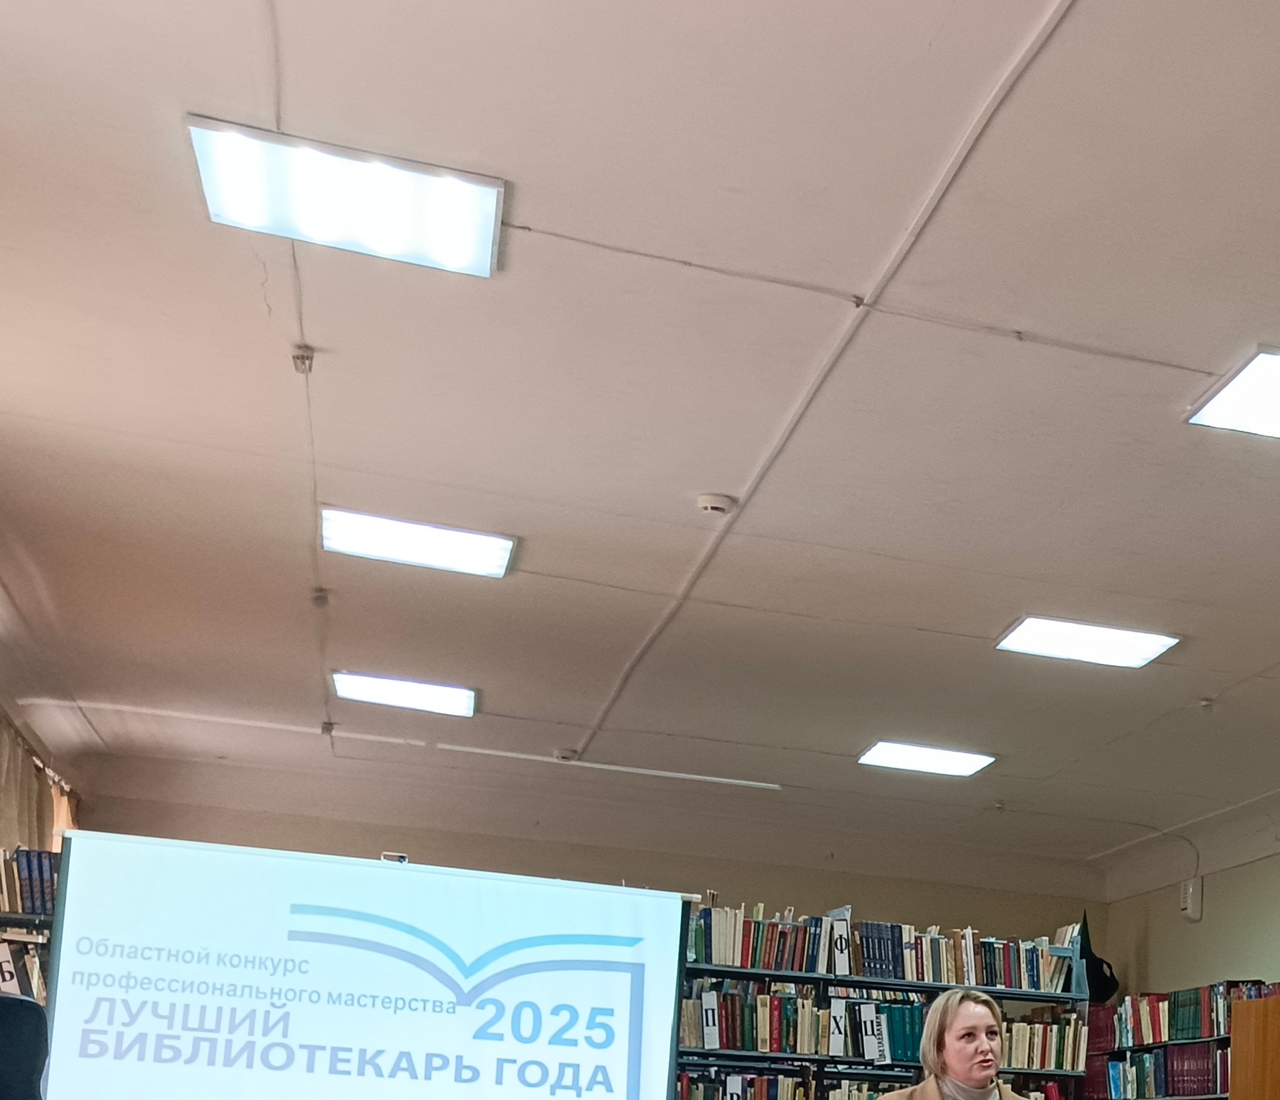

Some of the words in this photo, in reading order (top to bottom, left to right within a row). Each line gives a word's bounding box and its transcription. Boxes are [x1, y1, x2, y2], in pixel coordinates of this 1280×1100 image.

[75, 936, 211, 965] Областной
[216, 953, 310, 977] конкурс
[834, 934, 848, 954] Ф
[0, 960, 15, 983] Б
[71, 970, 321, 1004] профессионального
[327, 991, 457, 1014] мастерства
[83, 996, 291, 1039] ЛУЧШИЙ
[472, 997, 615, 1050] 2025
[704, 1008, 717, 1028] П
[831, 1015, 844, 1035] Х
[863, 1019, 877, 1038] Ц
[78, 1028, 481, 1084] БИБЛИОТЕКАРЬ
[495, 1057, 614, 1098] ГОДА
